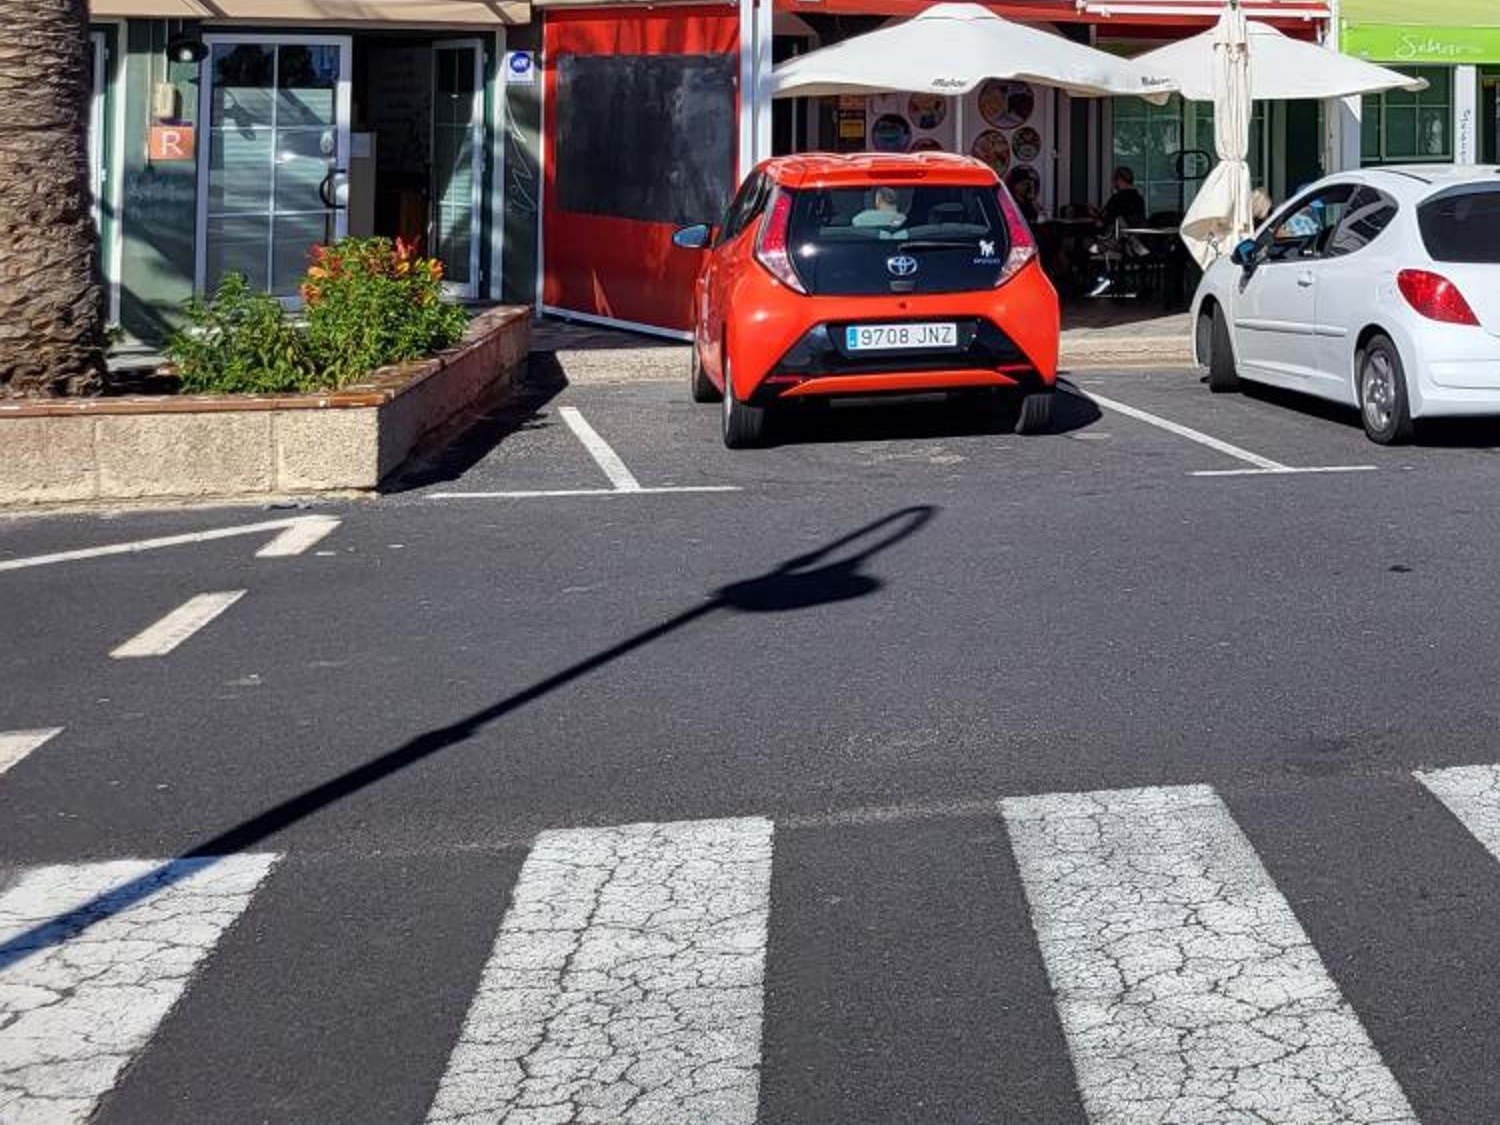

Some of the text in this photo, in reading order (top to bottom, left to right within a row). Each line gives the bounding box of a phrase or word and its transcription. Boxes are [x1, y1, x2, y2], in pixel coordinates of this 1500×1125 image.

[160, 131, 183, 156] R
[861, 326, 951, 346] 9708 JNZ
